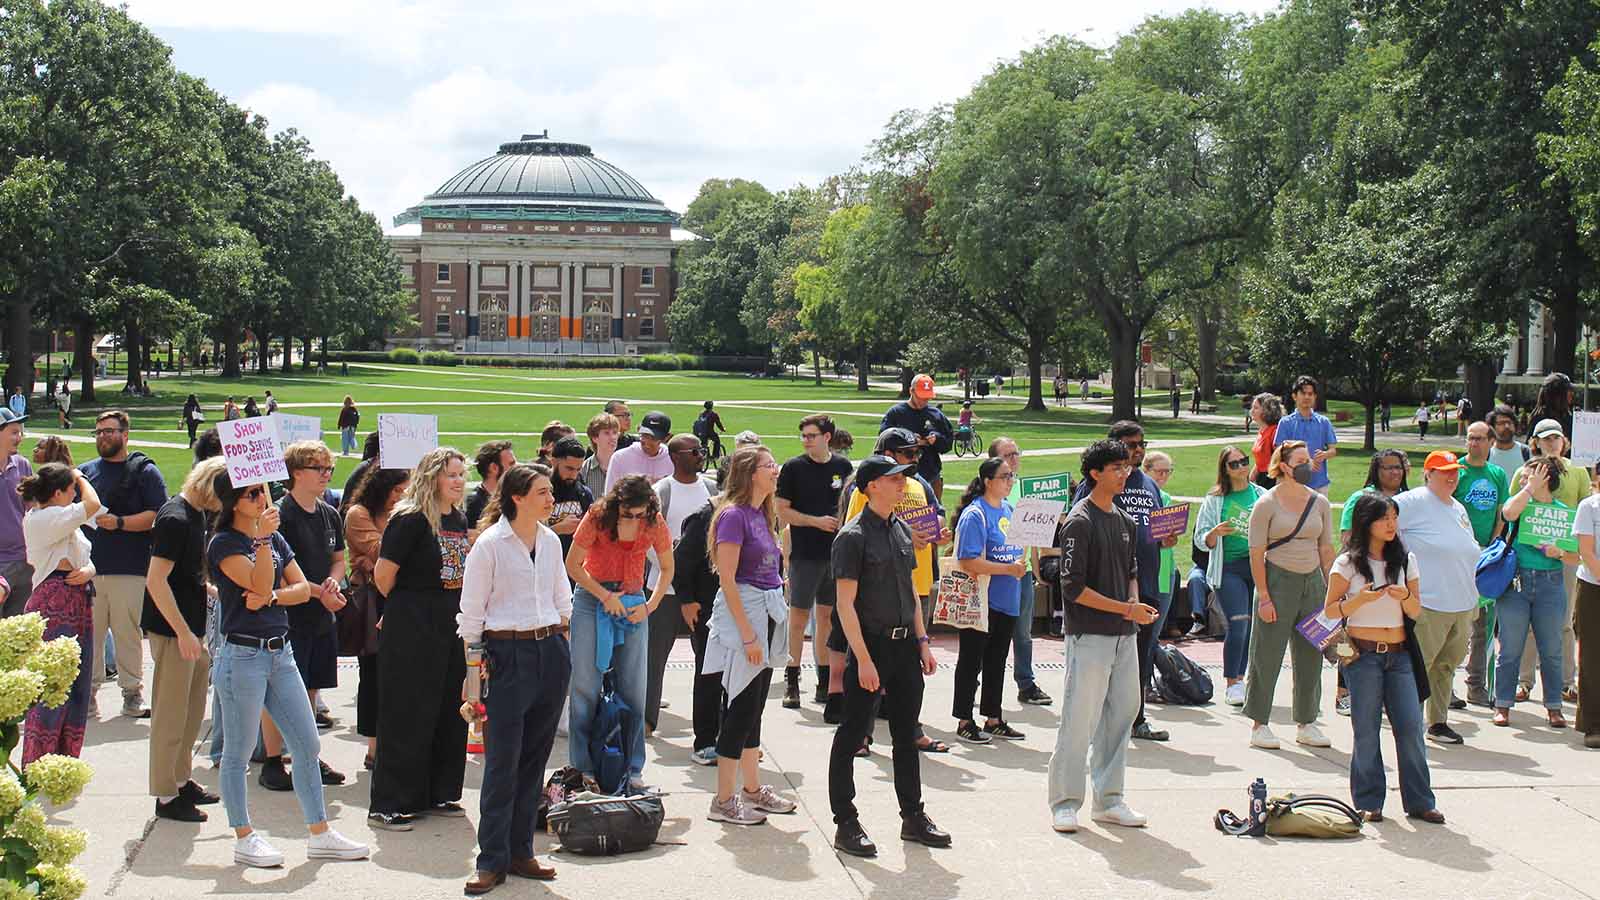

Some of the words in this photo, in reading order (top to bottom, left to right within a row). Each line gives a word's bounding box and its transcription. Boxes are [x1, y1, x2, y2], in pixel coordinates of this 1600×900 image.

[234, 422, 263, 439] SHOW
[224, 443, 248, 458] FOOD
[234, 464, 262, 480] SOME
[1033, 479, 1060, 491] FAIR
[1120, 496, 1153, 507] WORKS
[899, 507, 935, 520] LIDARITY
[1126, 506, 1150, 515] BECAUSE
[1150, 503, 1188, 518] SOLIDARITY
[1534, 506, 1569, 521] FAIR
[1022, 511, 1056, 525] LABOR
[1532, 525, 1568, 538] NOW!
[993, 553, 1013, 562] YOUR
[1060, 537, 1075, 577] RVCA
